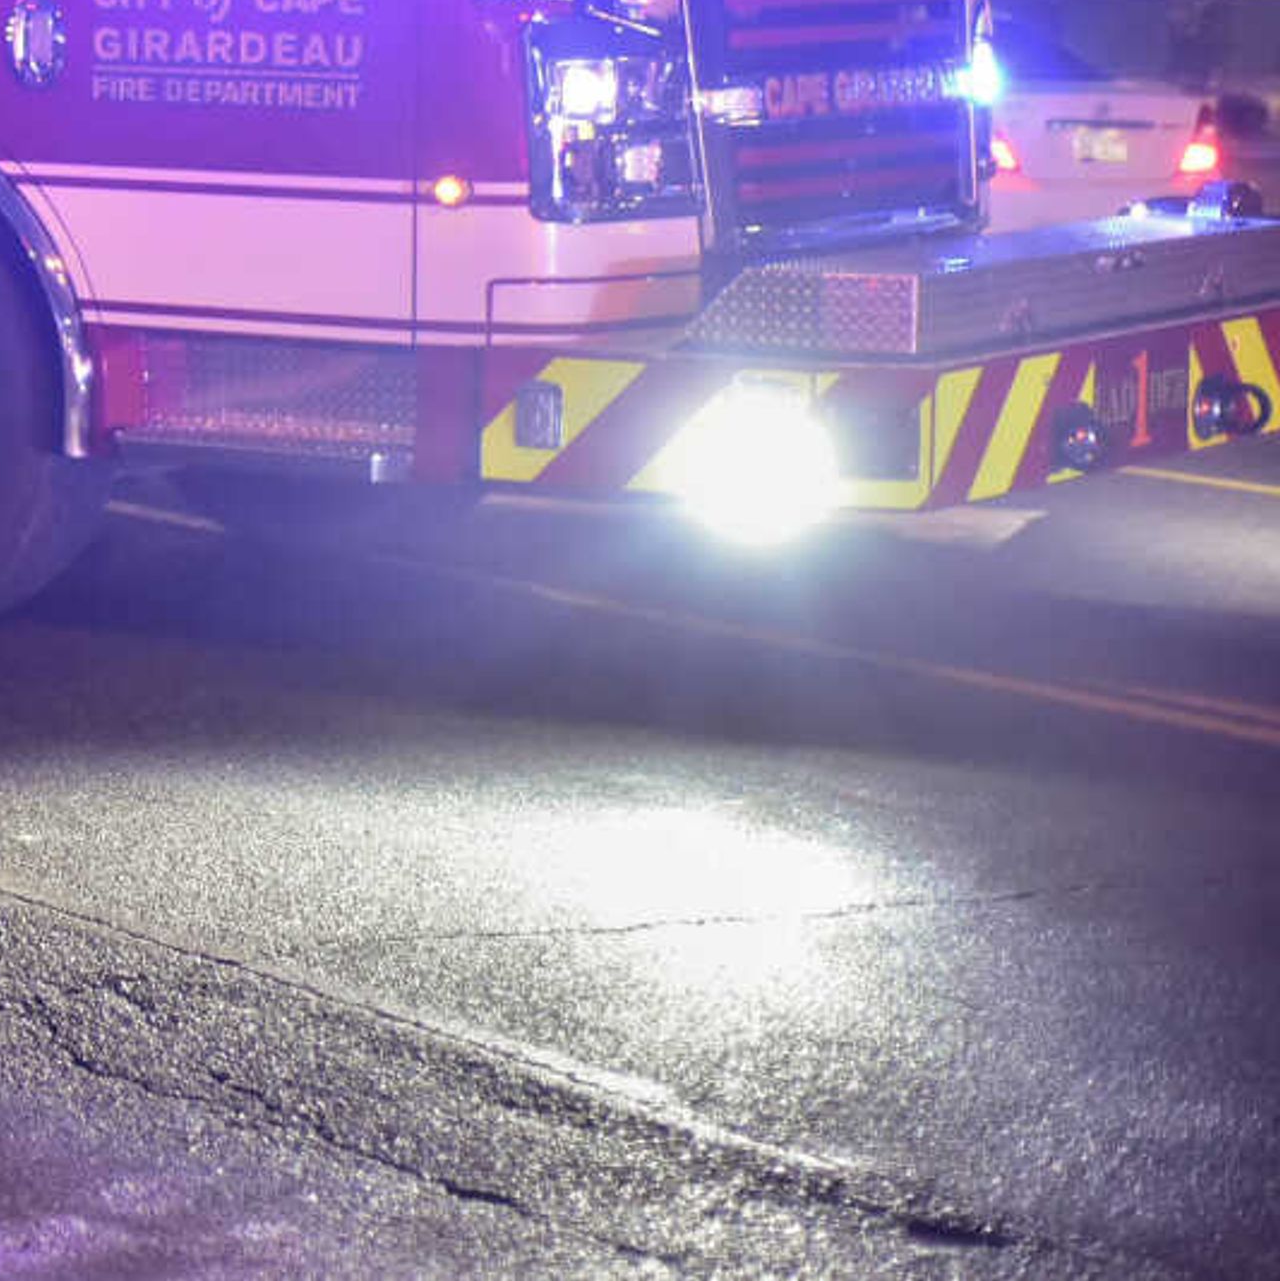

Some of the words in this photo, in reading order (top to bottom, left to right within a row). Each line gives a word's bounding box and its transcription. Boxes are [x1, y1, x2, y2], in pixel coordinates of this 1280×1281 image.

[93, 28, 363, 67] GIRARDEAU
[92, 76, 156, 102] FIRE
[165, 78, 360, 109] DEPARTMENT
